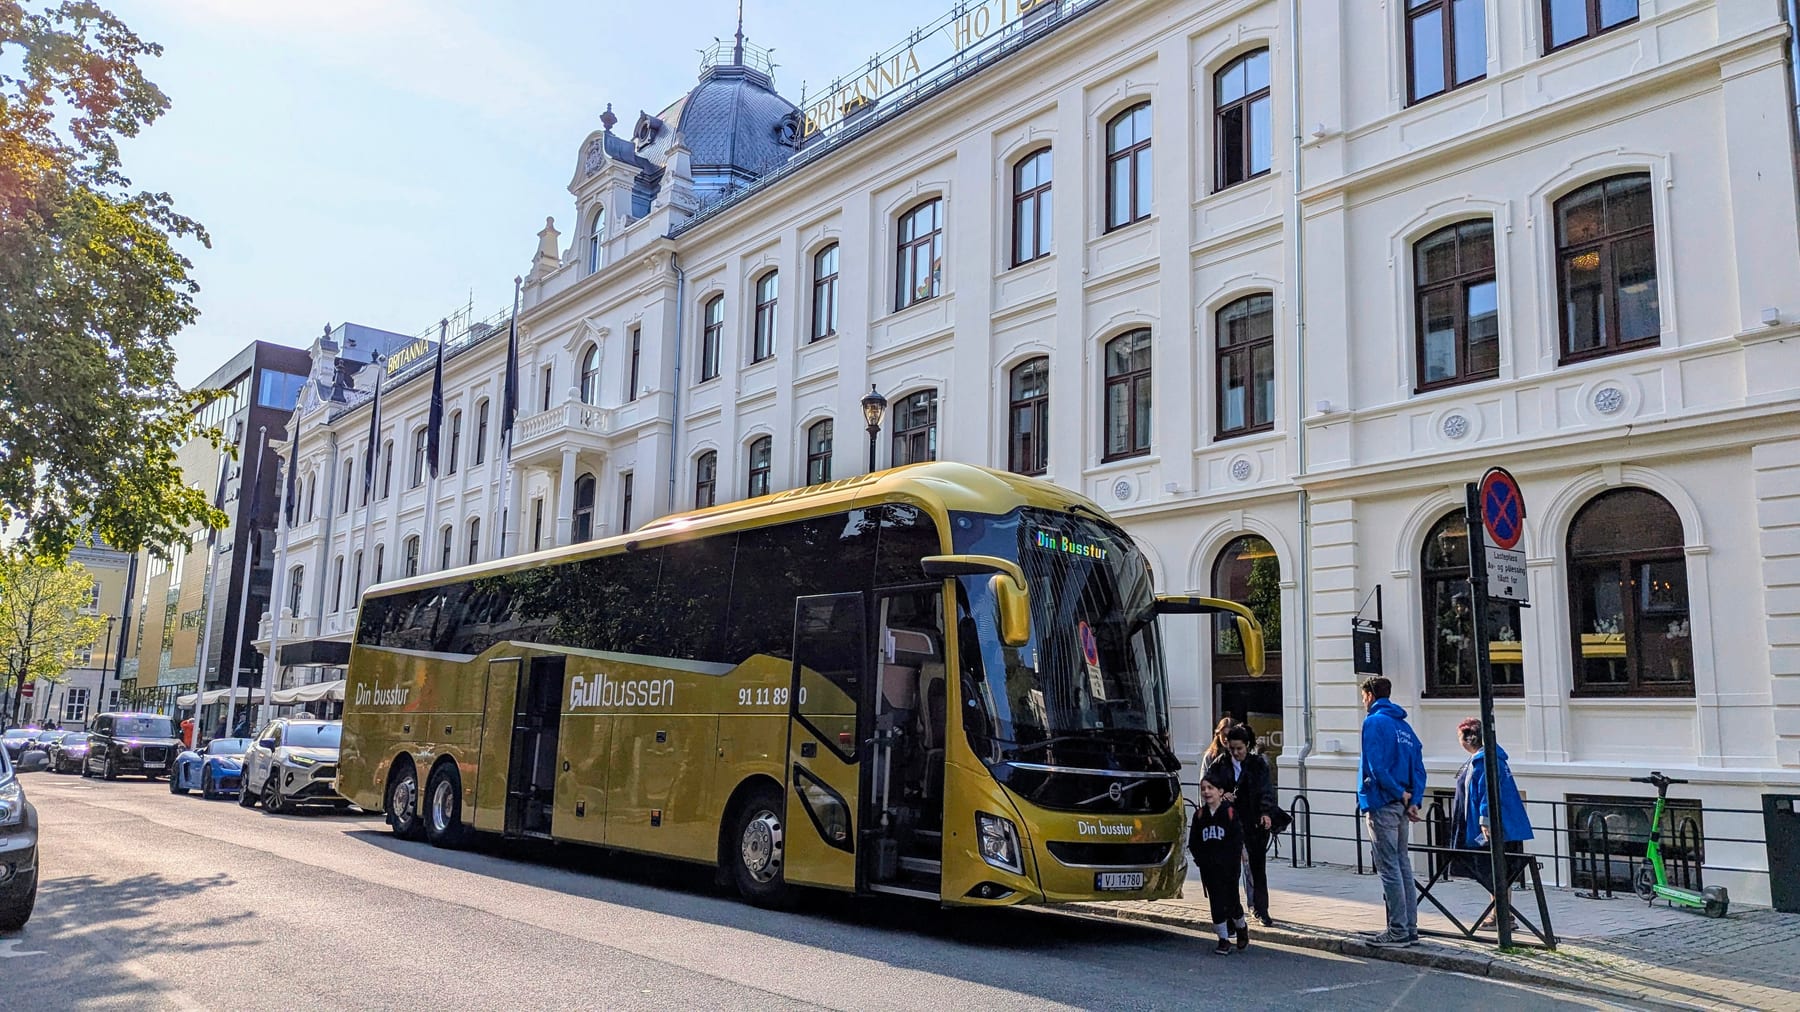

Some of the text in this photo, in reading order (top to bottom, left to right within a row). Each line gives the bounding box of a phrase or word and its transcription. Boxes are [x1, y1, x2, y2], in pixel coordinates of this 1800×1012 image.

[803, 48, 920, 138] BRITANNIA
[387, 336, 429, 374] BRITANNIA
[1036, 530, 1107, 560] Din Busstur
[355, 680, 409, 706] Din busstur
[569, 673, 675, 711] Gullbussen
[738, 688, 752, 705] 91
[756, 688, 769, 705] 11
[773, 687, 788, 705] 89
[1078, 819, 1133, 836] Din busstur
[1202, 825, 1226, 842] GAP
[1105, 874, 1141, 886] VJ 14780
